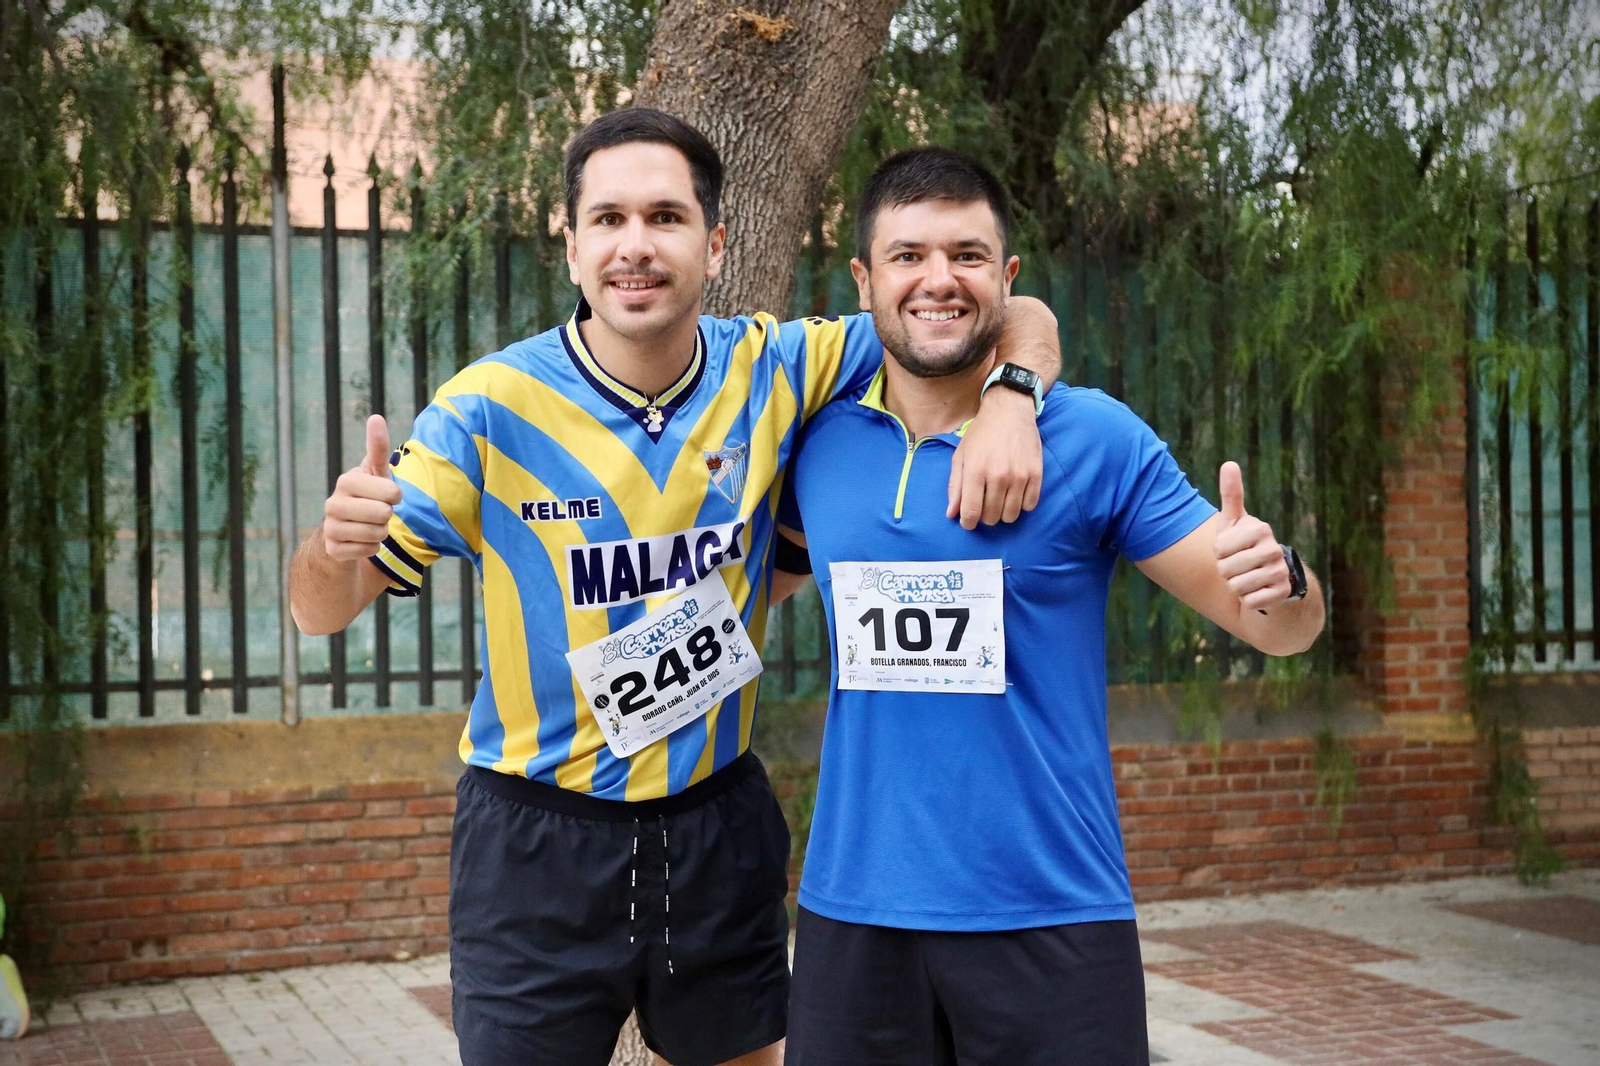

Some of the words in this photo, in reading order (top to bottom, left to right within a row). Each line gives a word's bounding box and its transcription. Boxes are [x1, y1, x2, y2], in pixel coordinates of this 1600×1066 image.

[521, 498, 600, 521] KELME
[879, 570, 949, 591] Carrera
[894, 589, 955, 603] Prensa
[622, 609, 688, 656] Carrera
[639, 618, 696, 657] Prensa
[858, 608, 970, 651] 107
[610, 625, 722, 716] 248
[871, 657, 895, 666] BOTELLA
[897, 658, 932, 667] GRANADOS,
[933, 658, 967, 667] FRANCISCO
[642, 705, 667, 721] DORADO
[667, 694, 686, 708] CAÑO,
[686, 684, 701, 698] JUAN
[700, 677, 708, 686] DE
[708, 668, 720, 682] DIOS
